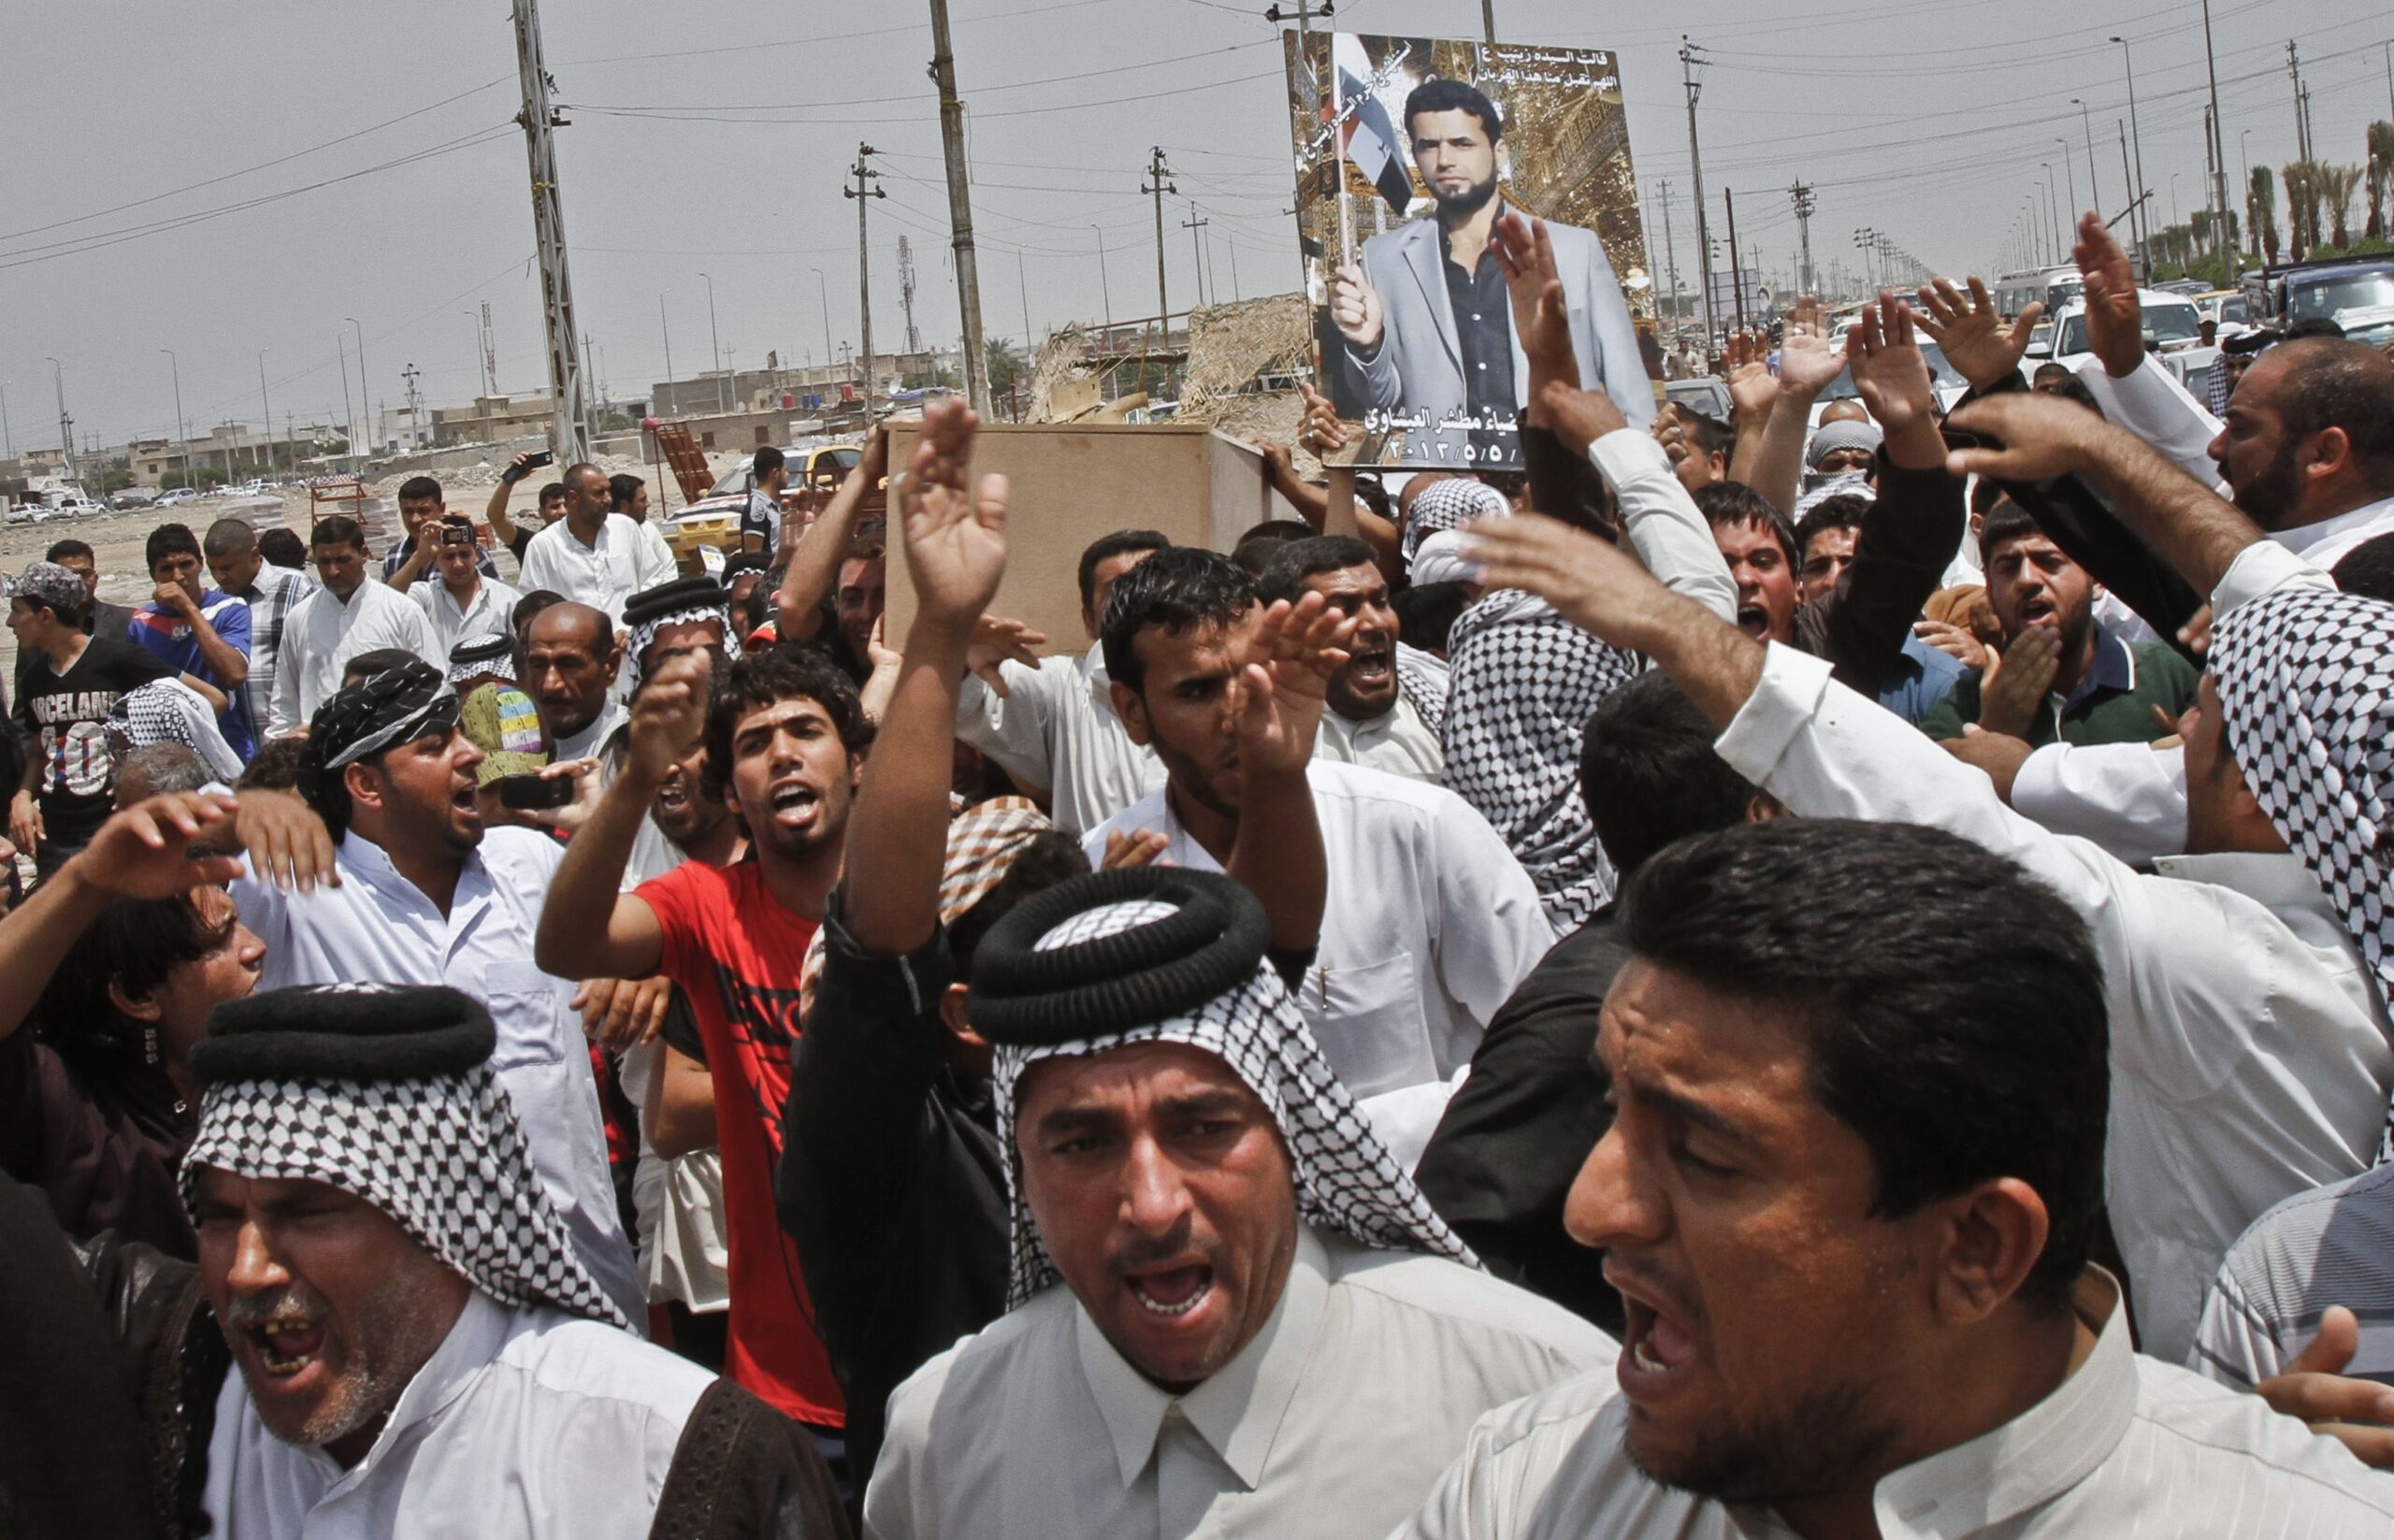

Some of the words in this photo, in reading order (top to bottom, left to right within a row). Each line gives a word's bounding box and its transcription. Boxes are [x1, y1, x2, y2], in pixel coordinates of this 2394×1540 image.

[1497, 48, 1532, 64] زينب
[1577, 50, 1608, 65] قالت
[1478, 67, 1520, 83] القربان
[1521, 69, 1542, 82] هذا
[1544, 71, 1561, 84] منا
[1564, 71, 1591, 89] تقبل
[1593, 75, 1618, 91] اللهم
[1311, 122, 1334, 149] زينب
[1434, 408, 1482, 436] مطشر
